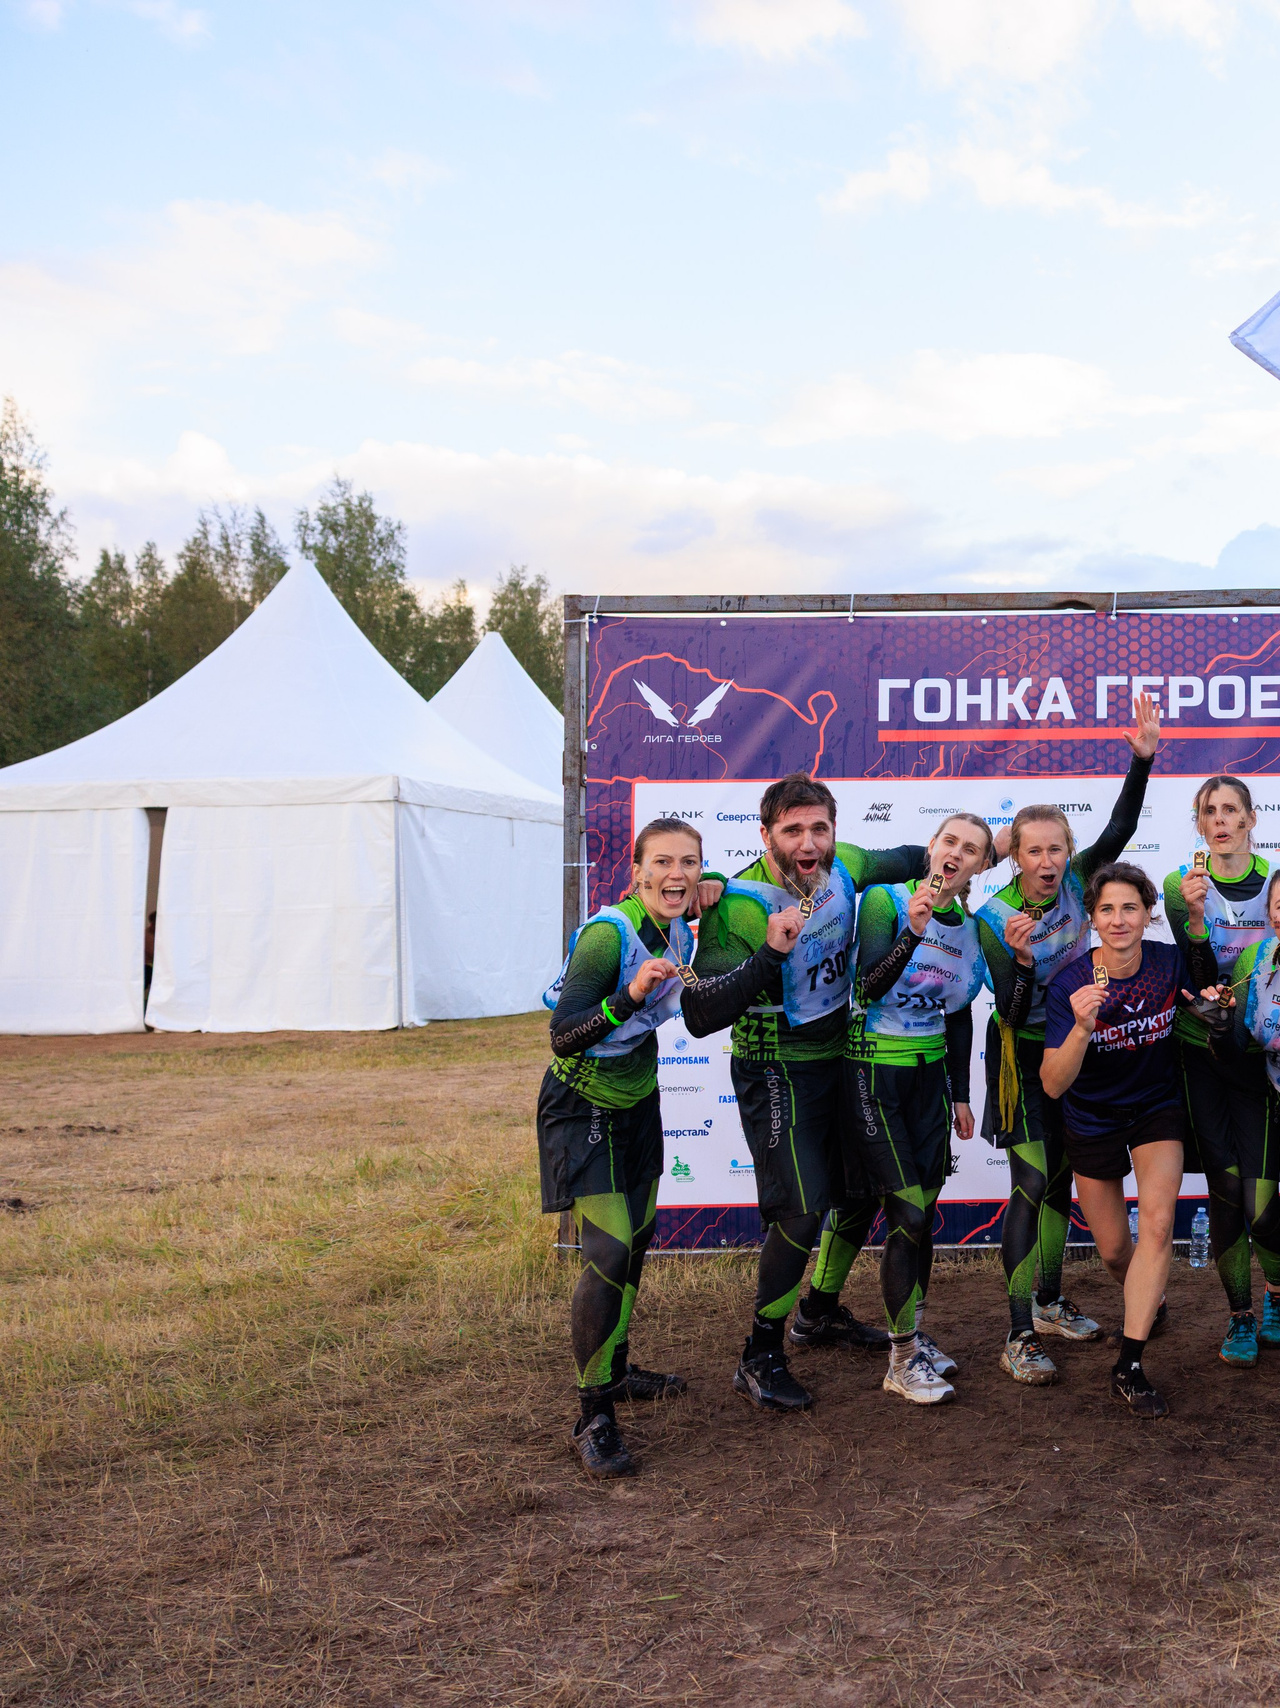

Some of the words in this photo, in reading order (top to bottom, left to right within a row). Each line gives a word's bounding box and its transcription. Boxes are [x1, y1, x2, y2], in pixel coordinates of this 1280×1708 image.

[878, 678, 1076, 722] ГОНКА
[643, 735, 674, 743] ЛИГА
[678, 734, 722, 743] ГЕРОЕВ
[659, 811, 704, 819] TANK
[868, 802, 893, 812] ANGRY
[716, 812, 761, 824] Северста
[862, 812, 892, 822] ANIMAL
[983, 817, 1014, 826] АЗПРОМ
[724, 849, 768, 857] TANK
[800, 914, 842, 945] Greenway
[1029, 930, 1047, 943] ОНКА
[1047, 913, 1071, 934] ГЕРОЕВ
[921, 937, 938, 946] НКА
[939, 942, 963, 956] ГЕРОЕВ
[1033, 937, 1080, 968] Greenway
[1209, 940, 1246, 954] Greenw
[861, 941, 908, 992] Greenway
[906, 958, 957, 983] Greenway
[896, 991, 947, 1010] 73
[1006, 977, 1028, 1028] reenway
[549, 1011, 608, 1049] eenway
[1089, 1004, 1177, 1043] ИНСТРУКТОР
[1097, 1036, 1136, 1053] ГОНКА
[1138, 1023, 1173, 1045] ГЕРОЕВ
[657, 1056, 710, 1065] АЗПРОМБАНК
[658, 1085, 699, 1095] Greenway
[767, 1073, 782, 1149] Greenway
[855, 1075, 878, 1137] Greenway
[663, 1128, 710, 1139] версталь
[986, 1158, 1009, 1166] Gree
